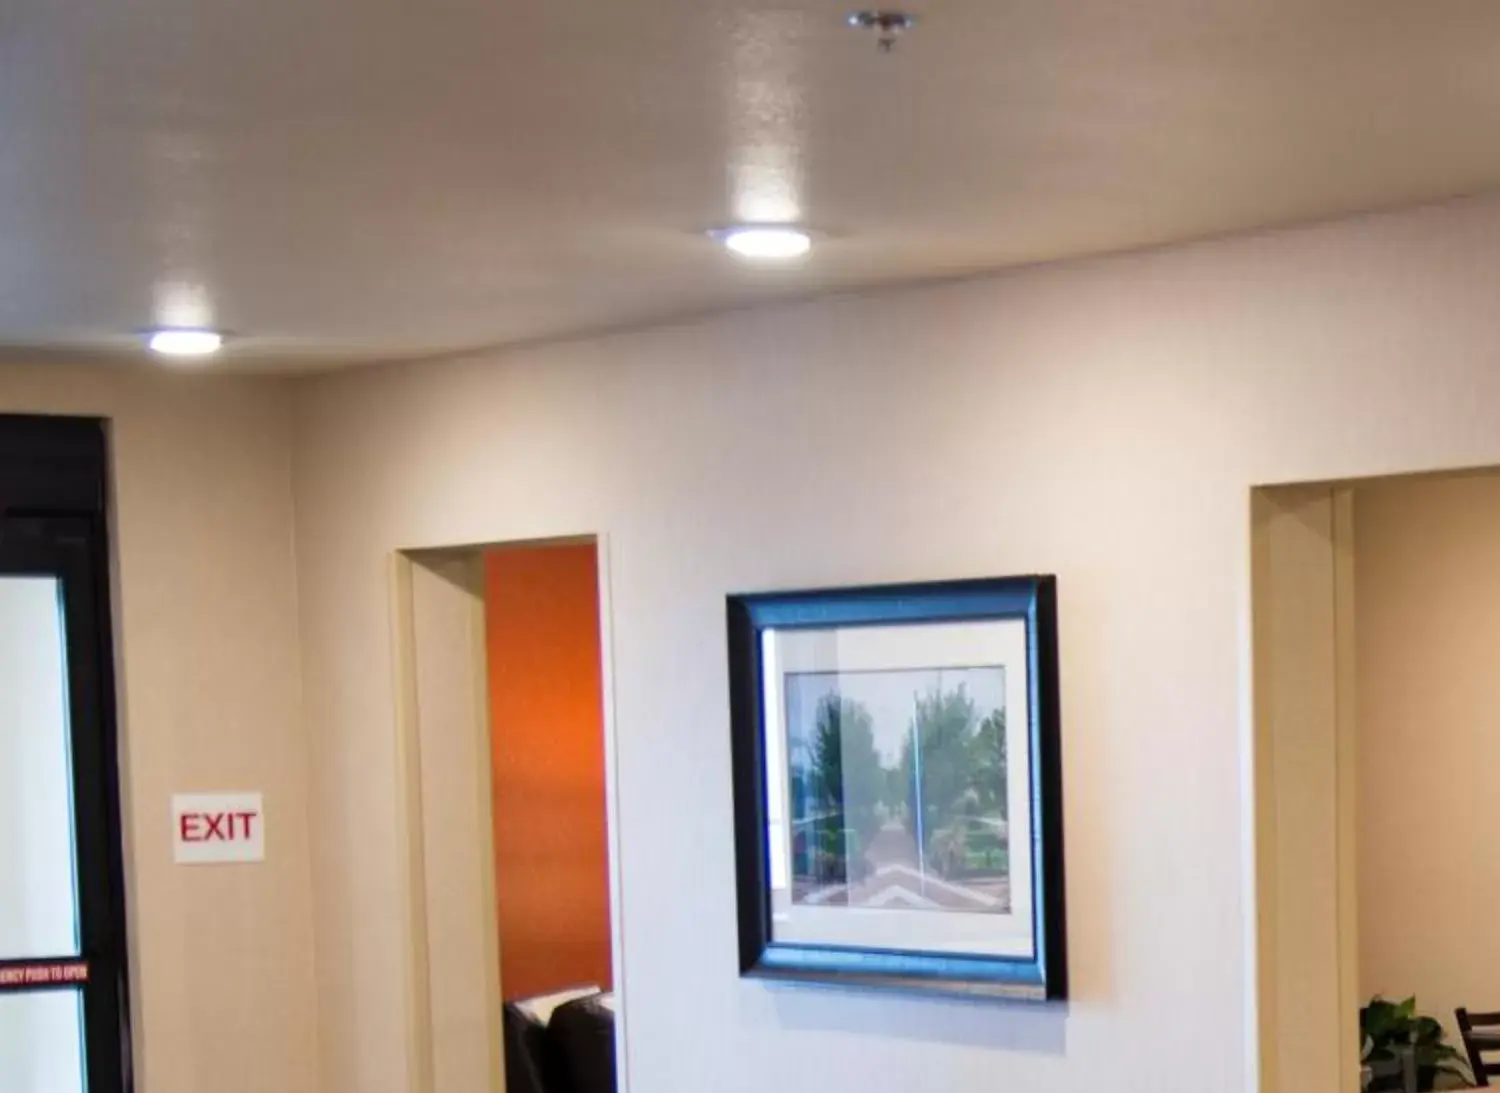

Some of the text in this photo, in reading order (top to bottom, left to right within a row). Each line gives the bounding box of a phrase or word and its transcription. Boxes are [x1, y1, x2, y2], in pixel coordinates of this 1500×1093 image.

[181, 811, 258, 842] EXIT
[51, 965, 63, 981] TO
[63, 964, 87, 980] OPEN
